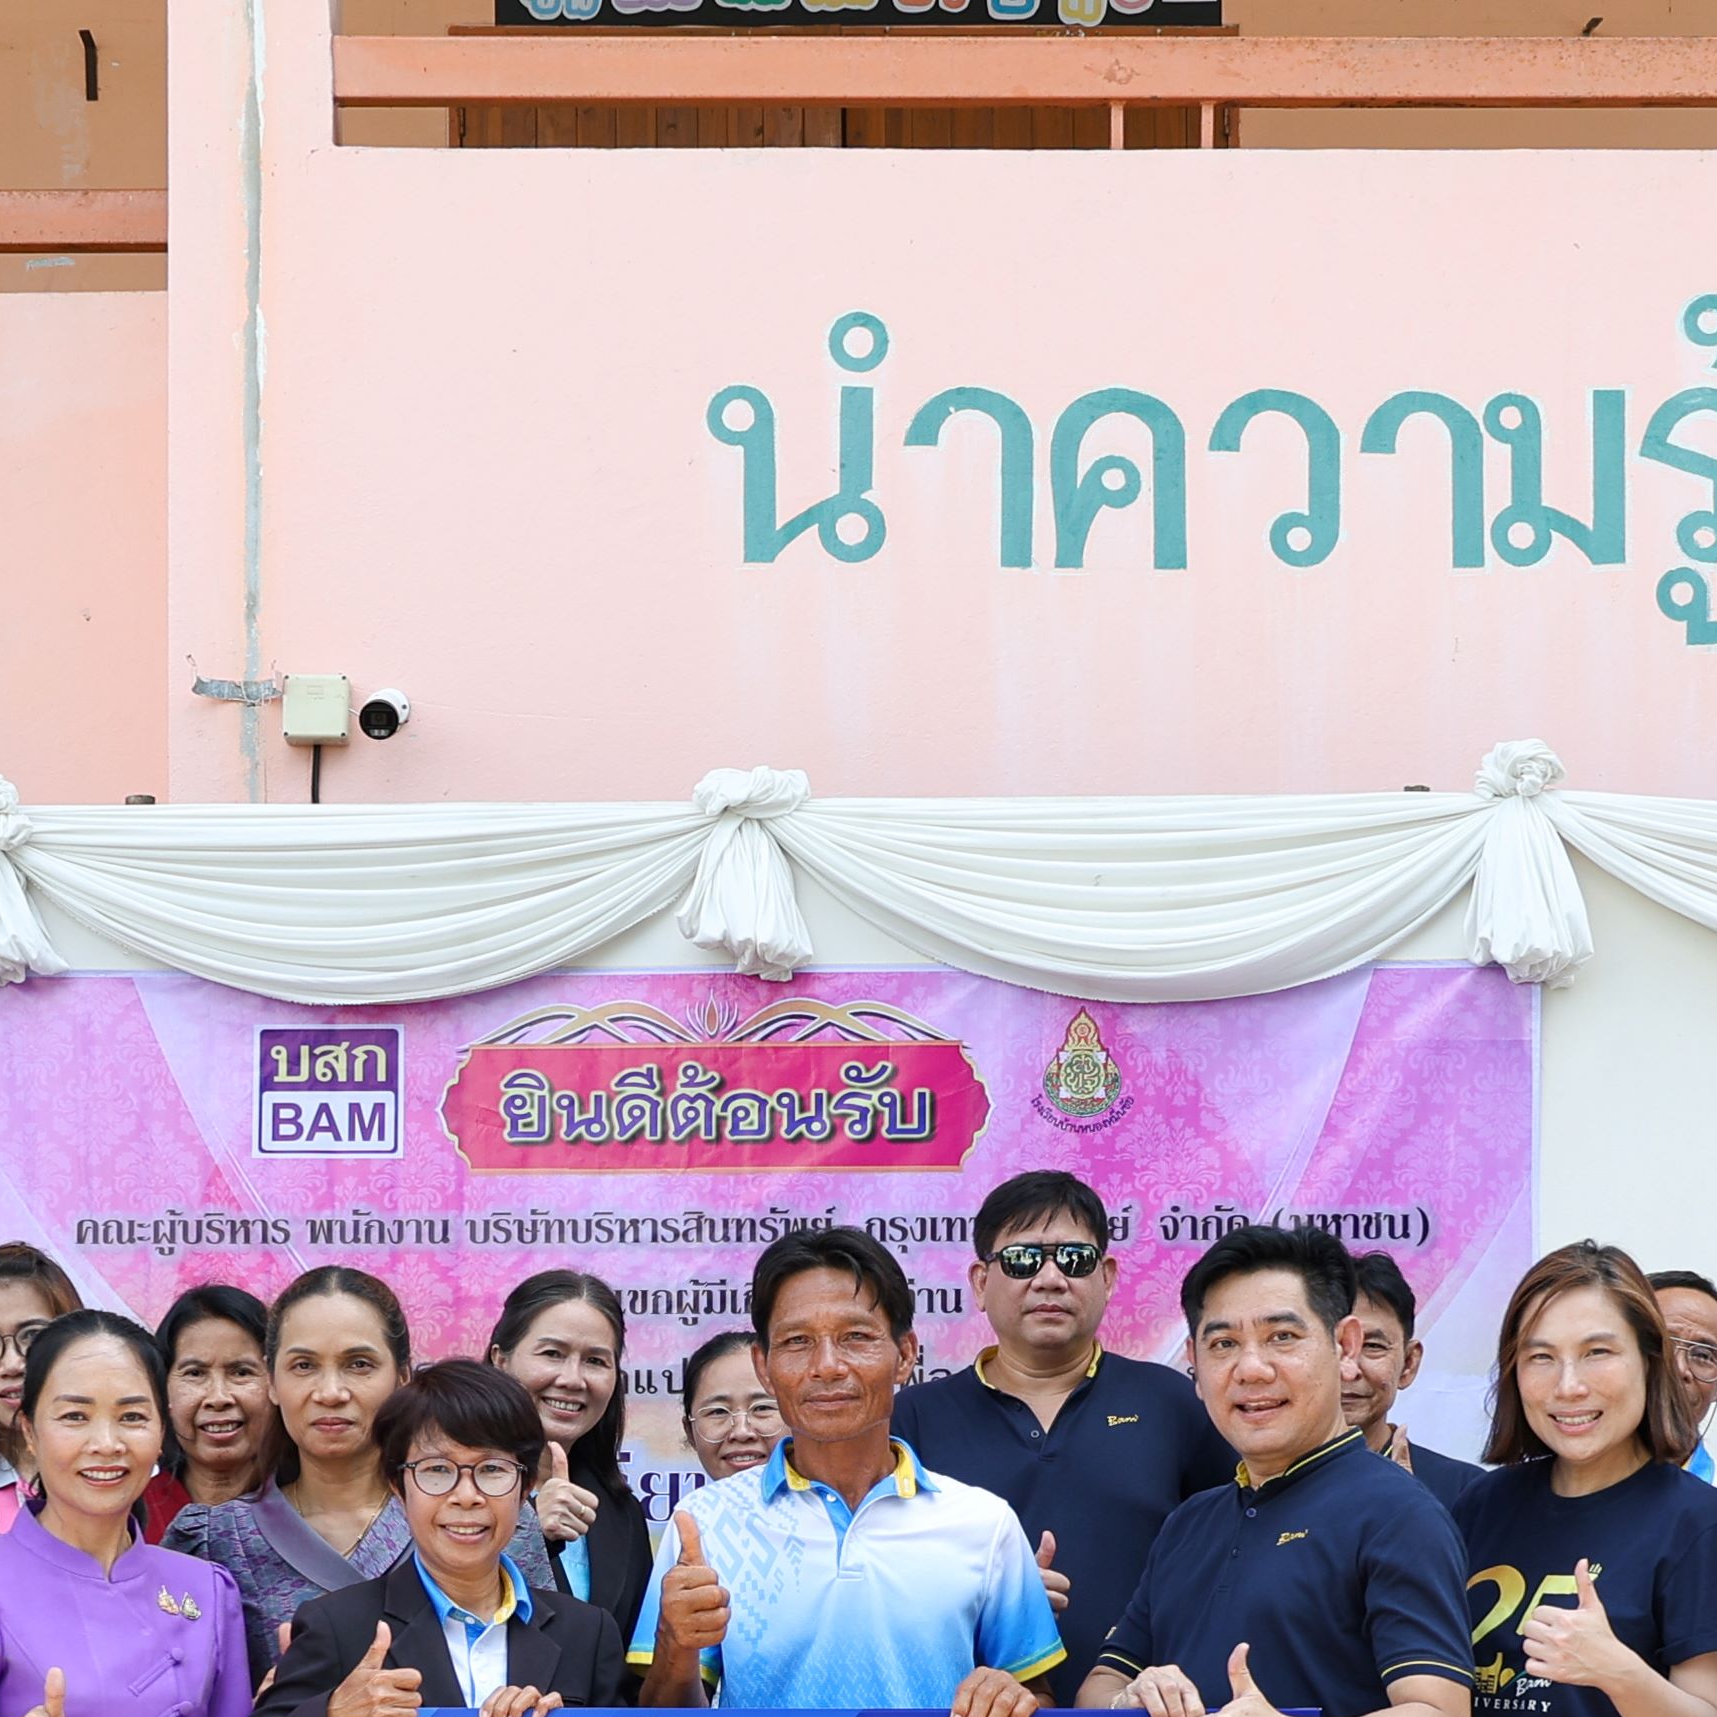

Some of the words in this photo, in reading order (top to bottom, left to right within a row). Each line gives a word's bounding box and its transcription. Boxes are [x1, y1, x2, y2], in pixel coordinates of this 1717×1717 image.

[270, 1042, 387, 1083] บสก
[270, 1102, 388, 1142] BAM
[501, 1062, 933, 1143] ยินดีต้อนรับ
[75, 1210, 291, 1256] คณะผู้บริหาร
[306, 1209, 450, 1245] พนักงาน
[1474, 1697, 1551, 1712] IVERSARY
